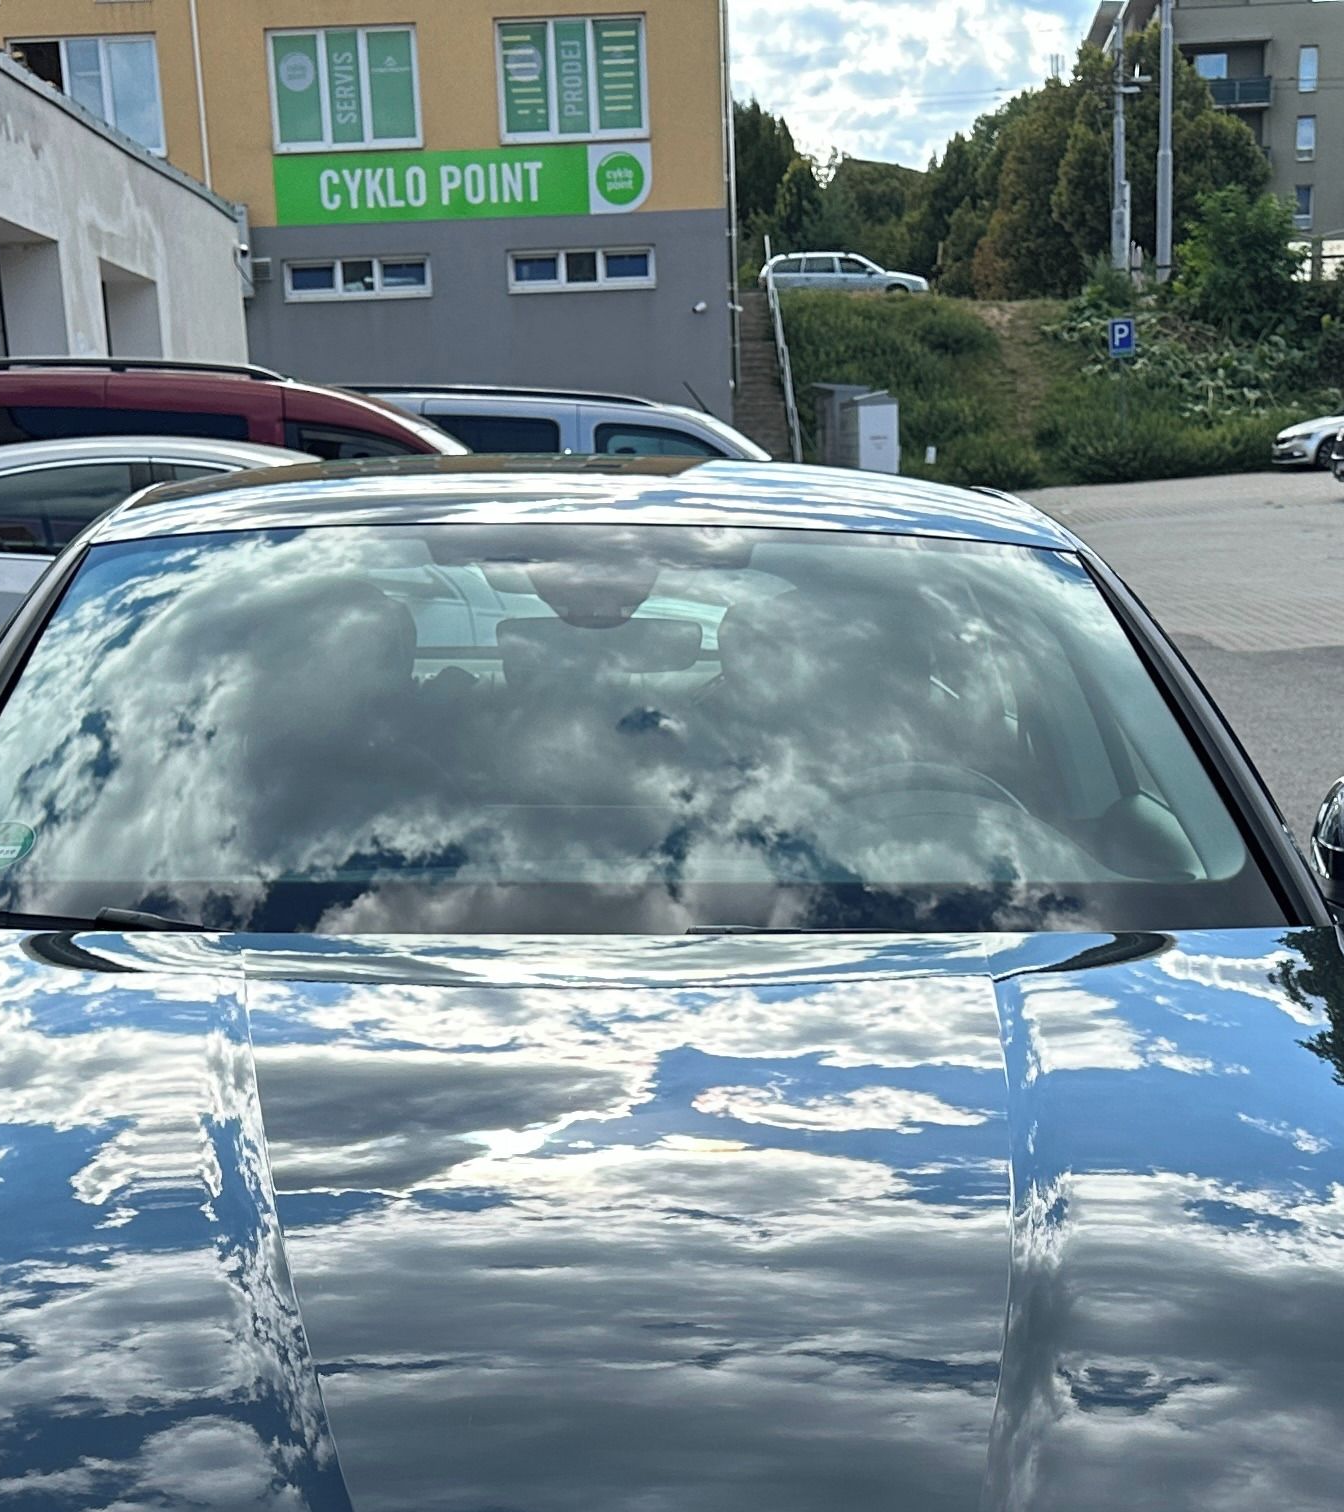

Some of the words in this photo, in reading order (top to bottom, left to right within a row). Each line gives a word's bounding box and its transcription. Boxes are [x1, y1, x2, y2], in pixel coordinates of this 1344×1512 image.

[333, 51, 356, 125] SERVIS
[560, 40, 585, 117] PRODEJ
[319, 165, 427, 211] CYKLO
[439, 161, 543, 206] POINT
[1114, 324, 1130, 347] P
